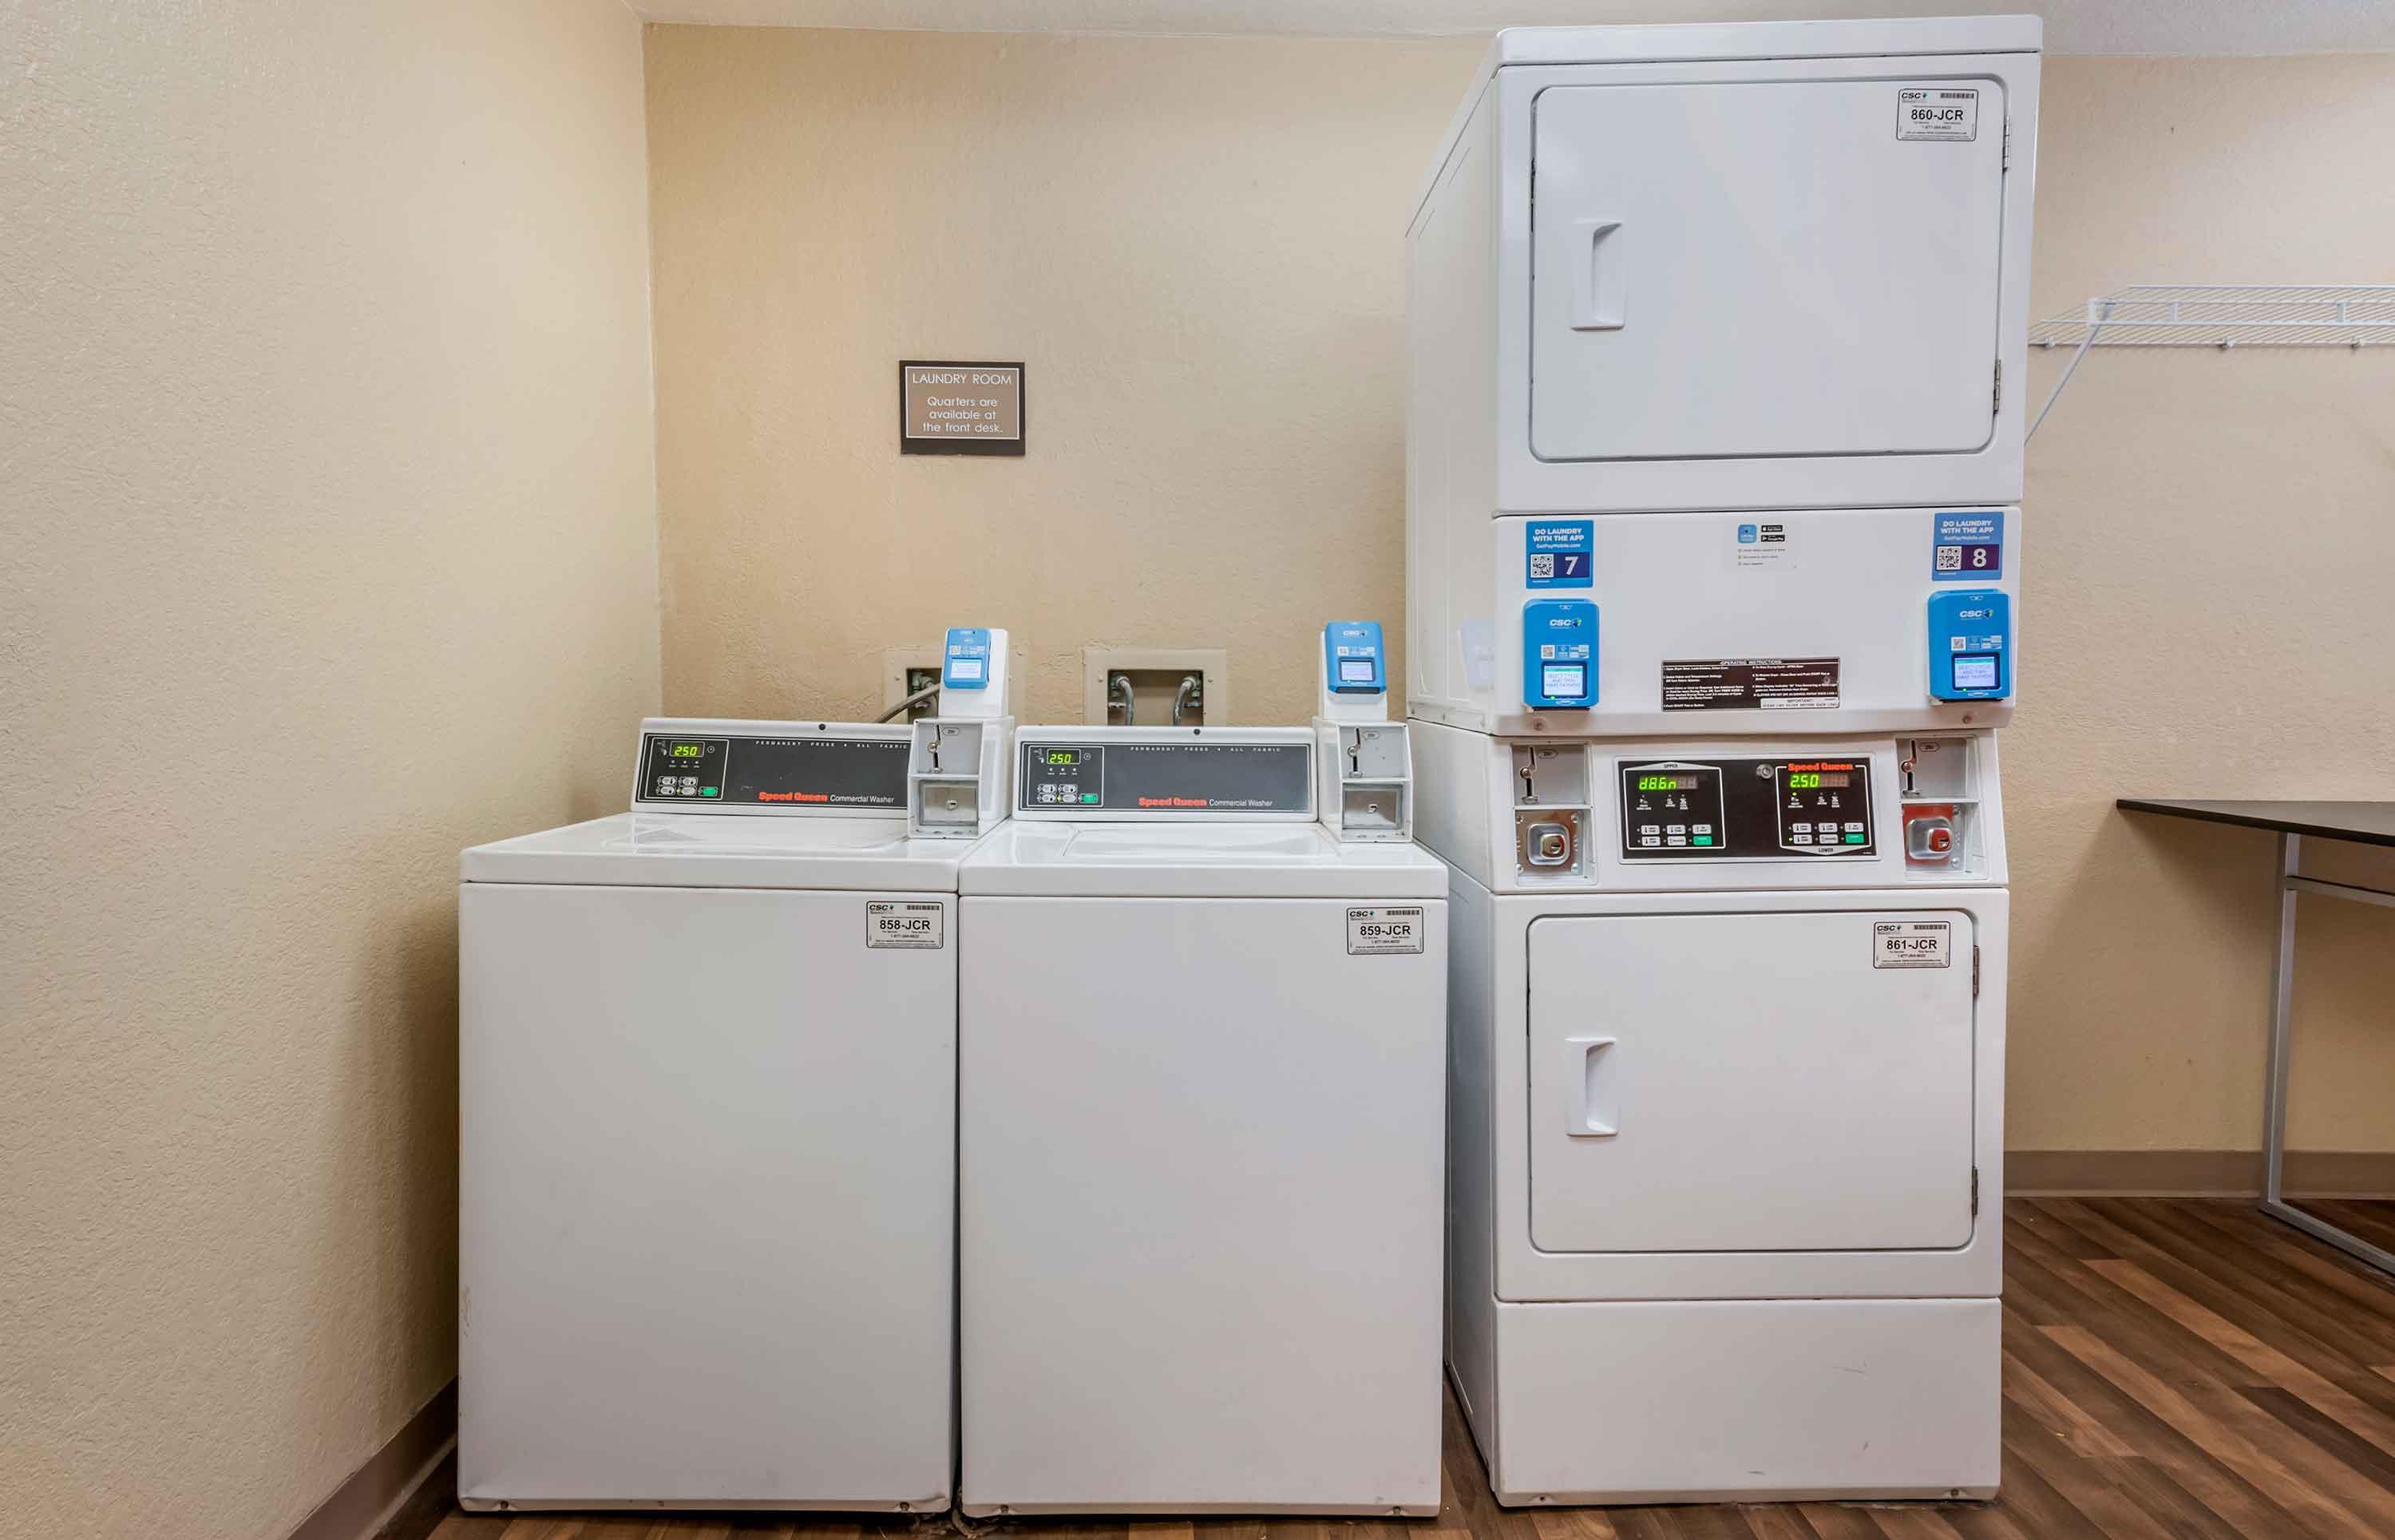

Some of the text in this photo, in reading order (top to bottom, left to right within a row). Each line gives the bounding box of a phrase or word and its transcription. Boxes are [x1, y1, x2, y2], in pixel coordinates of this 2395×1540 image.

[1910, 109, 1964, 121] 860-JCR
[912, 374, 1011, 385] LAUNDRY ROOM
[927, 396, 997, 407] Quarters are
[929, 410, 997, 420] available at
[923, 423, 1004, 433] the front desk.
[1973, 548, 1987, 568] 8
[1565, 556, 1579, 576] 7
[1788, 762, 1853, 772] Speed Queen
[758, 791, 793, 802] Speed
[794, 792, 828, 802] Queen
[829, 794, 869, 803] Commercial
[1139, 798, 1171, 806] Speed
[1173, 798, 1207, 806] Queen
[880, 919, 931, 930] 858-JCR
[1360, 925, 1411, 936] 859-JCR
[1886, 939, 1938, 949] 861-JCR
